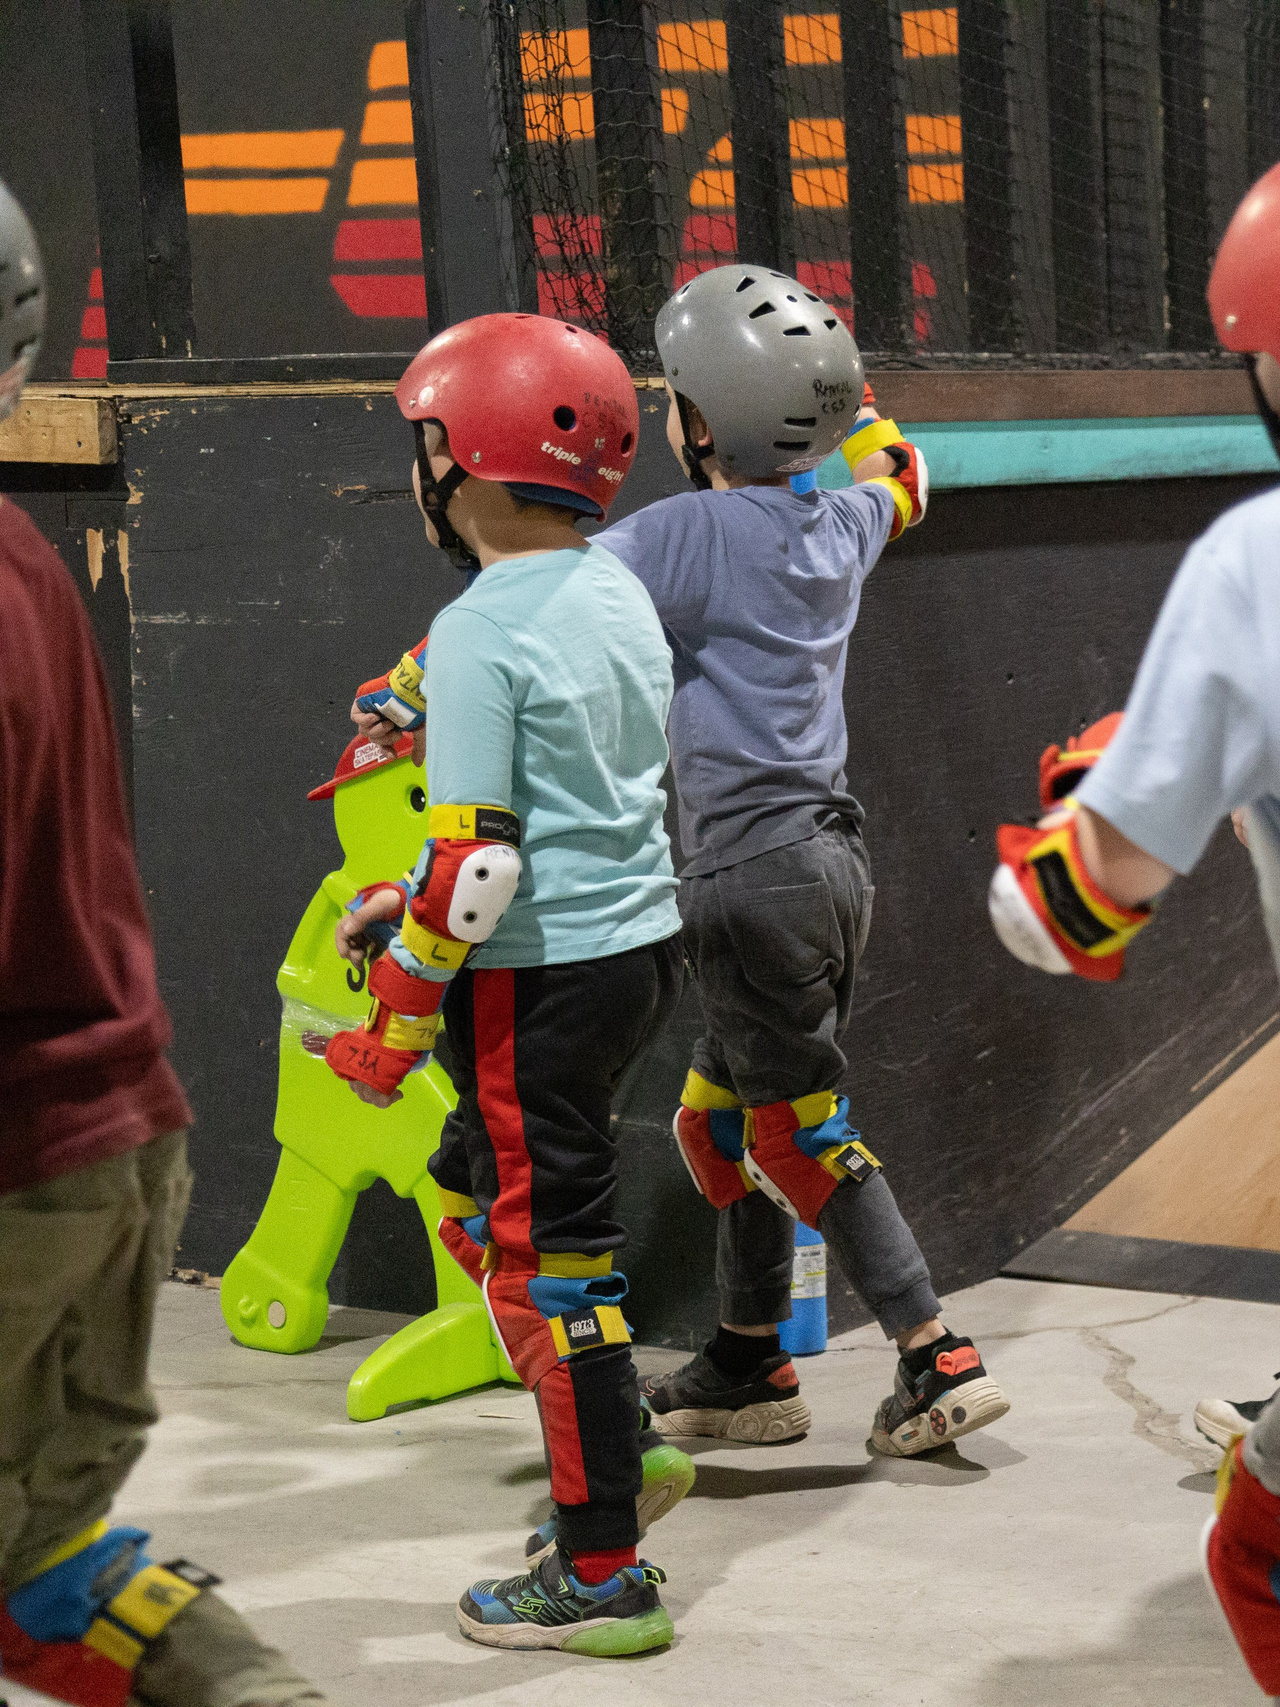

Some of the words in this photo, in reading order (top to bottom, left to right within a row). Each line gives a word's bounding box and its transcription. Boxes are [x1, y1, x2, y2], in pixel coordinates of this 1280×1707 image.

[540, 440, 581, 465] triple
[431, 943, 448, 962] L
[569, 1318, 595, 1337] 1973
